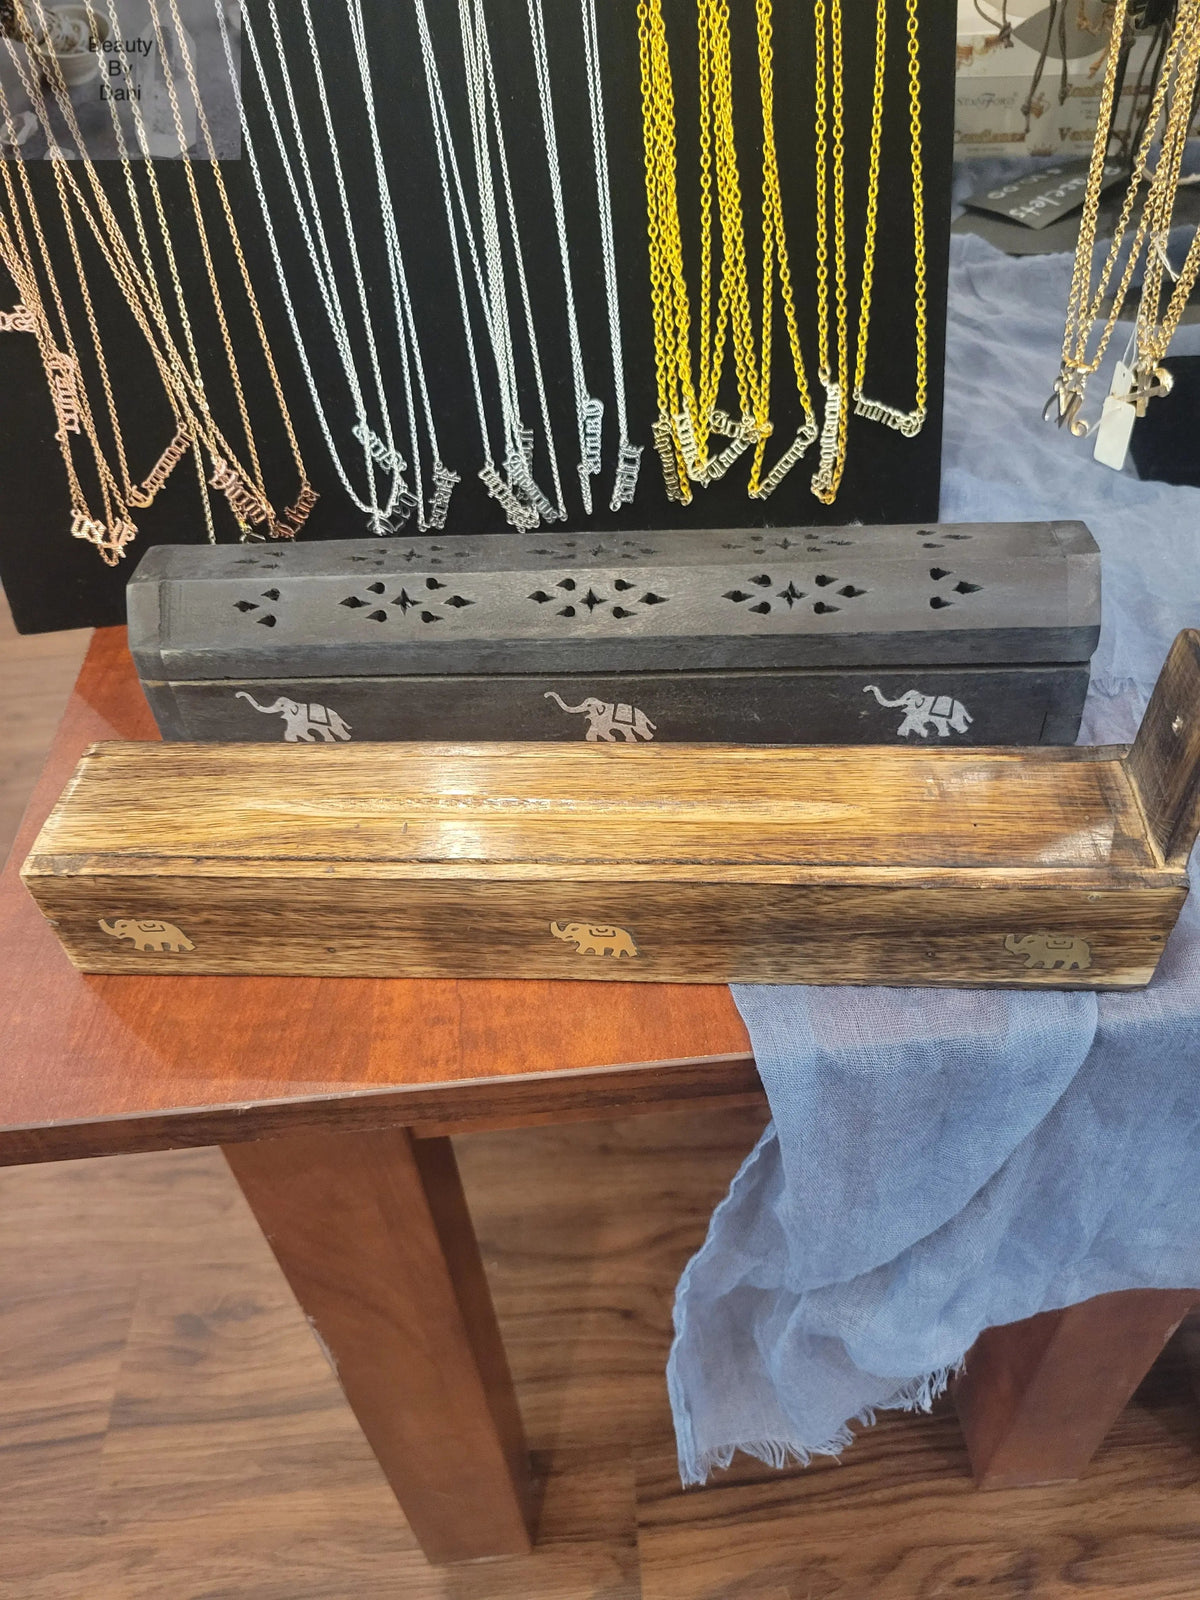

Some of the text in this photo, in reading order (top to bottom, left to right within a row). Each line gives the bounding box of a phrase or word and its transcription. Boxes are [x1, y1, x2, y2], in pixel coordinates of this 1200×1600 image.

[88, 36, 153, 57] Beauty
[99, 85, 141, 101] Dani
[1008, 164, 1122, 219] Bacelets
